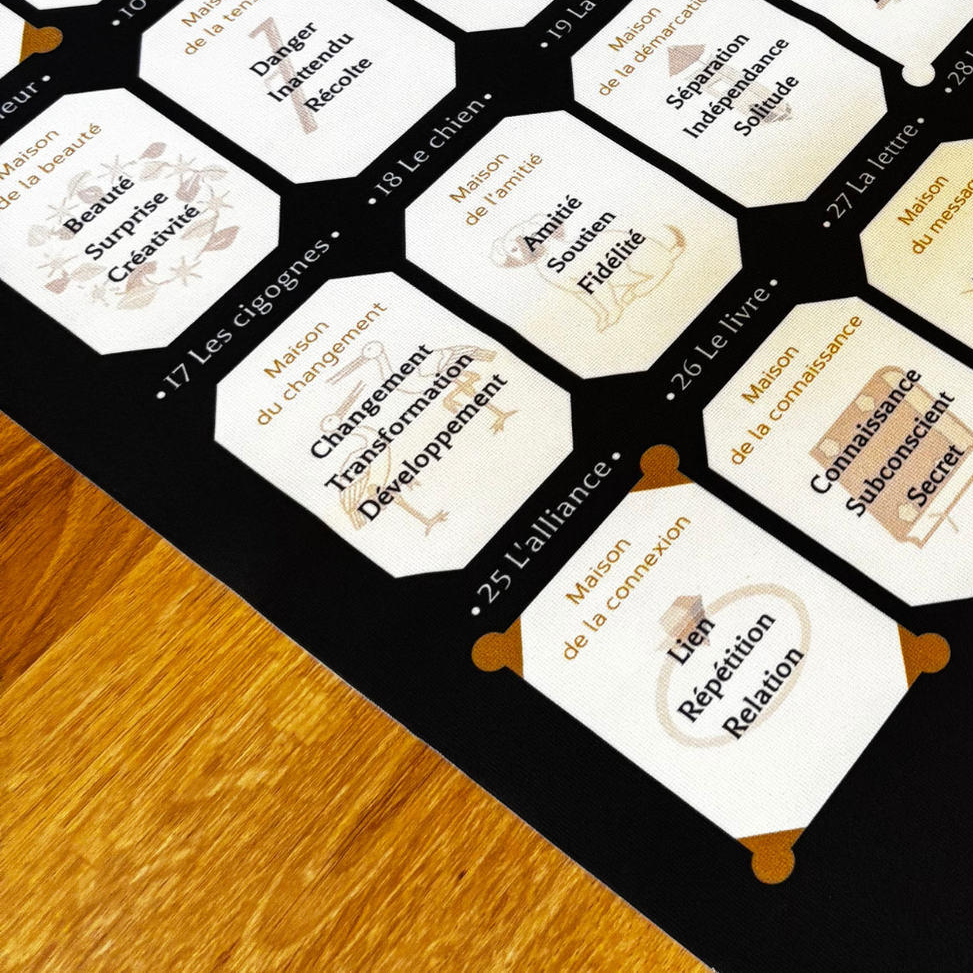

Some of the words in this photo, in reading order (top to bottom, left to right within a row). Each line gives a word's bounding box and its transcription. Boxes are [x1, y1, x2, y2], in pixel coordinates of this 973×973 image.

[248, 21, 318, 78] Danger
[266, 32, 355, 103] Inattendu
[302, 57, 374, 114] Récolte
[665, 33, 751, 111] Séparation
[681, 38, 790, 140] Indépendance
[733, 75, 800, 138] Solitude
[62, 174, 136, 236] Beauté
[83, 192, 170, 262] Surprise
[522, 193, 584, 254] Amitié
[107, 203, 201, 284] Créativité
[546, 211, 618, 275] Soutien
[575, 227, 647, 296] Fidélité
[162, 362, 191, 390] 17
[186, 327, 234, 366] Les
[232, 239, 331, 328] cigognes
[262, 321, 330, 380] Maison
[256, 401, 284, 427] du
[282, 301, 388, 402] changement
[309, 343, 435, 460] Changement
[323, 353, 475, 493] Transformation
[355, 373, 509, 523] Développement
[475, 568, 513, 605] 25
[503, 461, 613, 570] L'alliance
[666, 617, 717, 666] Lien
[676, 613, 777, 724] Répétition
[720, 647, 806, 741] Relation
